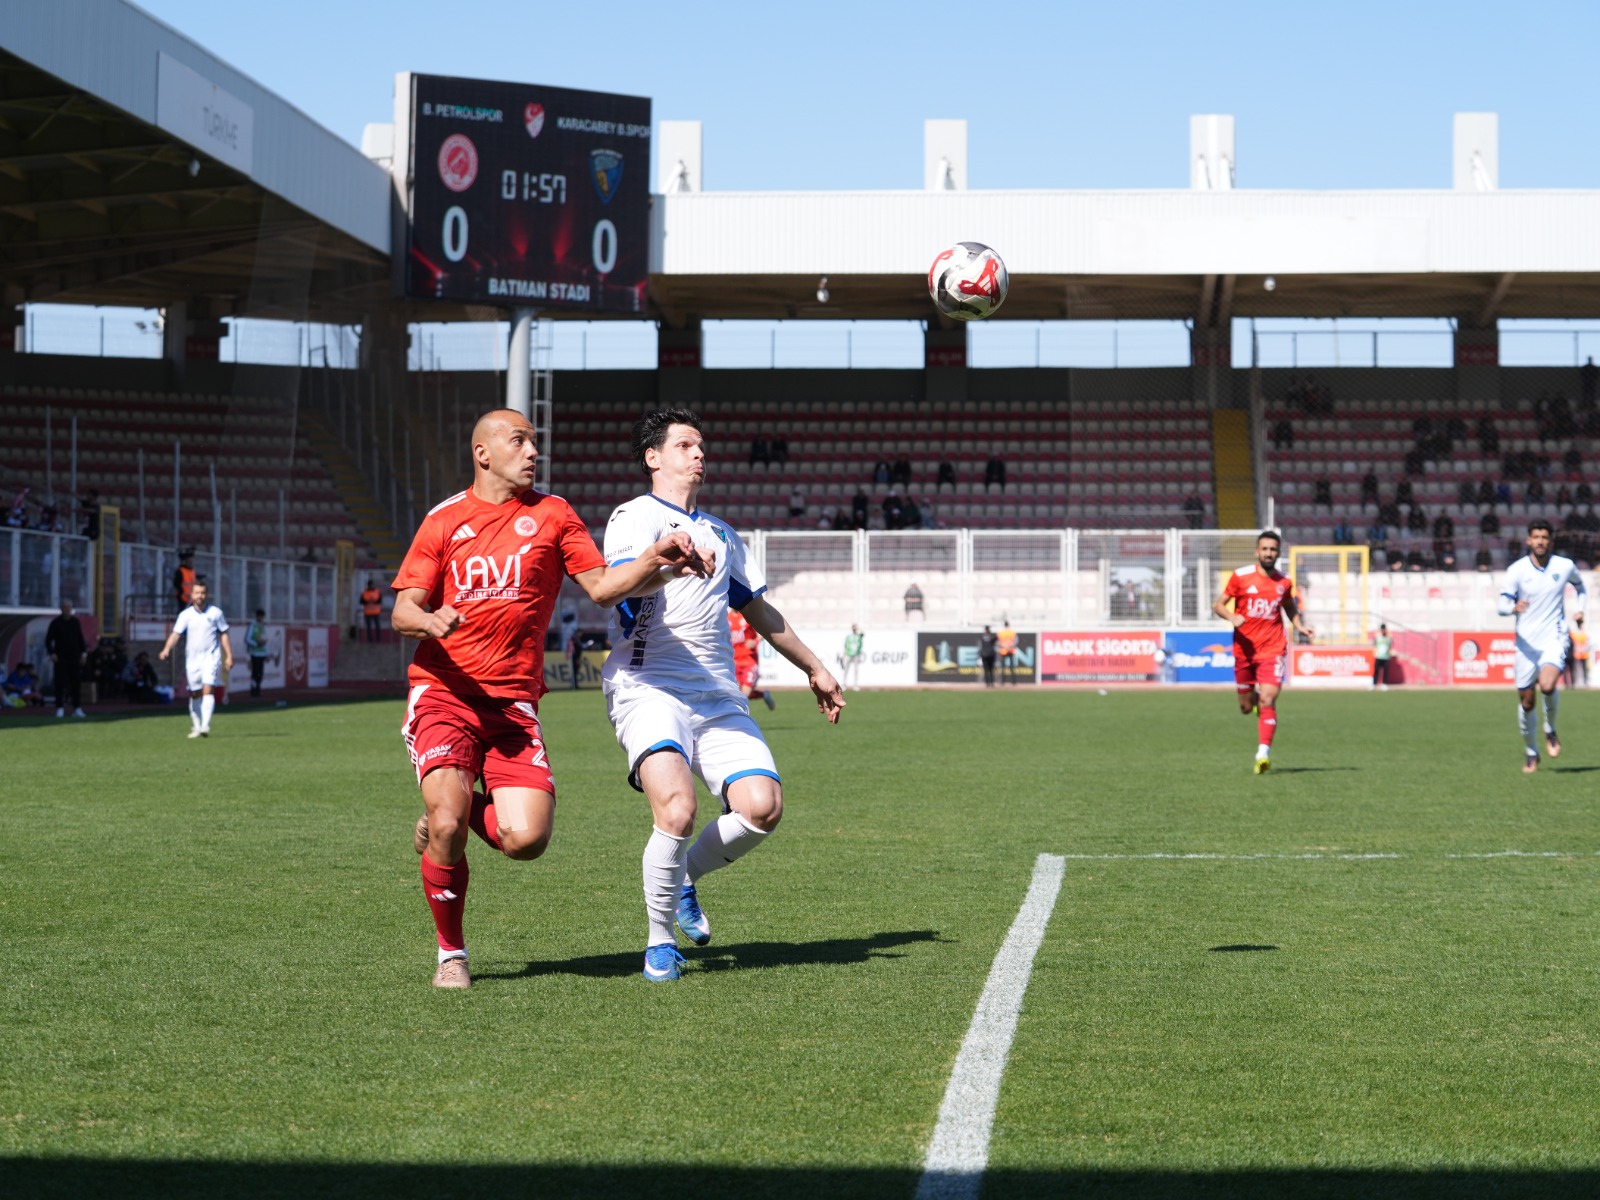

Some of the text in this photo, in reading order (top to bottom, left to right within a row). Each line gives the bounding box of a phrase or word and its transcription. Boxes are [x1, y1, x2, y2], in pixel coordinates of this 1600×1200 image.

[423, 102, 503, 123] B. PETROLSPOR
[557, 116, 616, 135] KARACABEY
[502, 170, 566, 204] 01:57
[442, 206, 468, 262] 0
[592, 219, 617, 274] 0
[488, 278, 591, 302] BATMAN STADI
[1043, 636, 1157, 656] BADUK SİGORTA
[871, 651, 909, 664] GRUP
